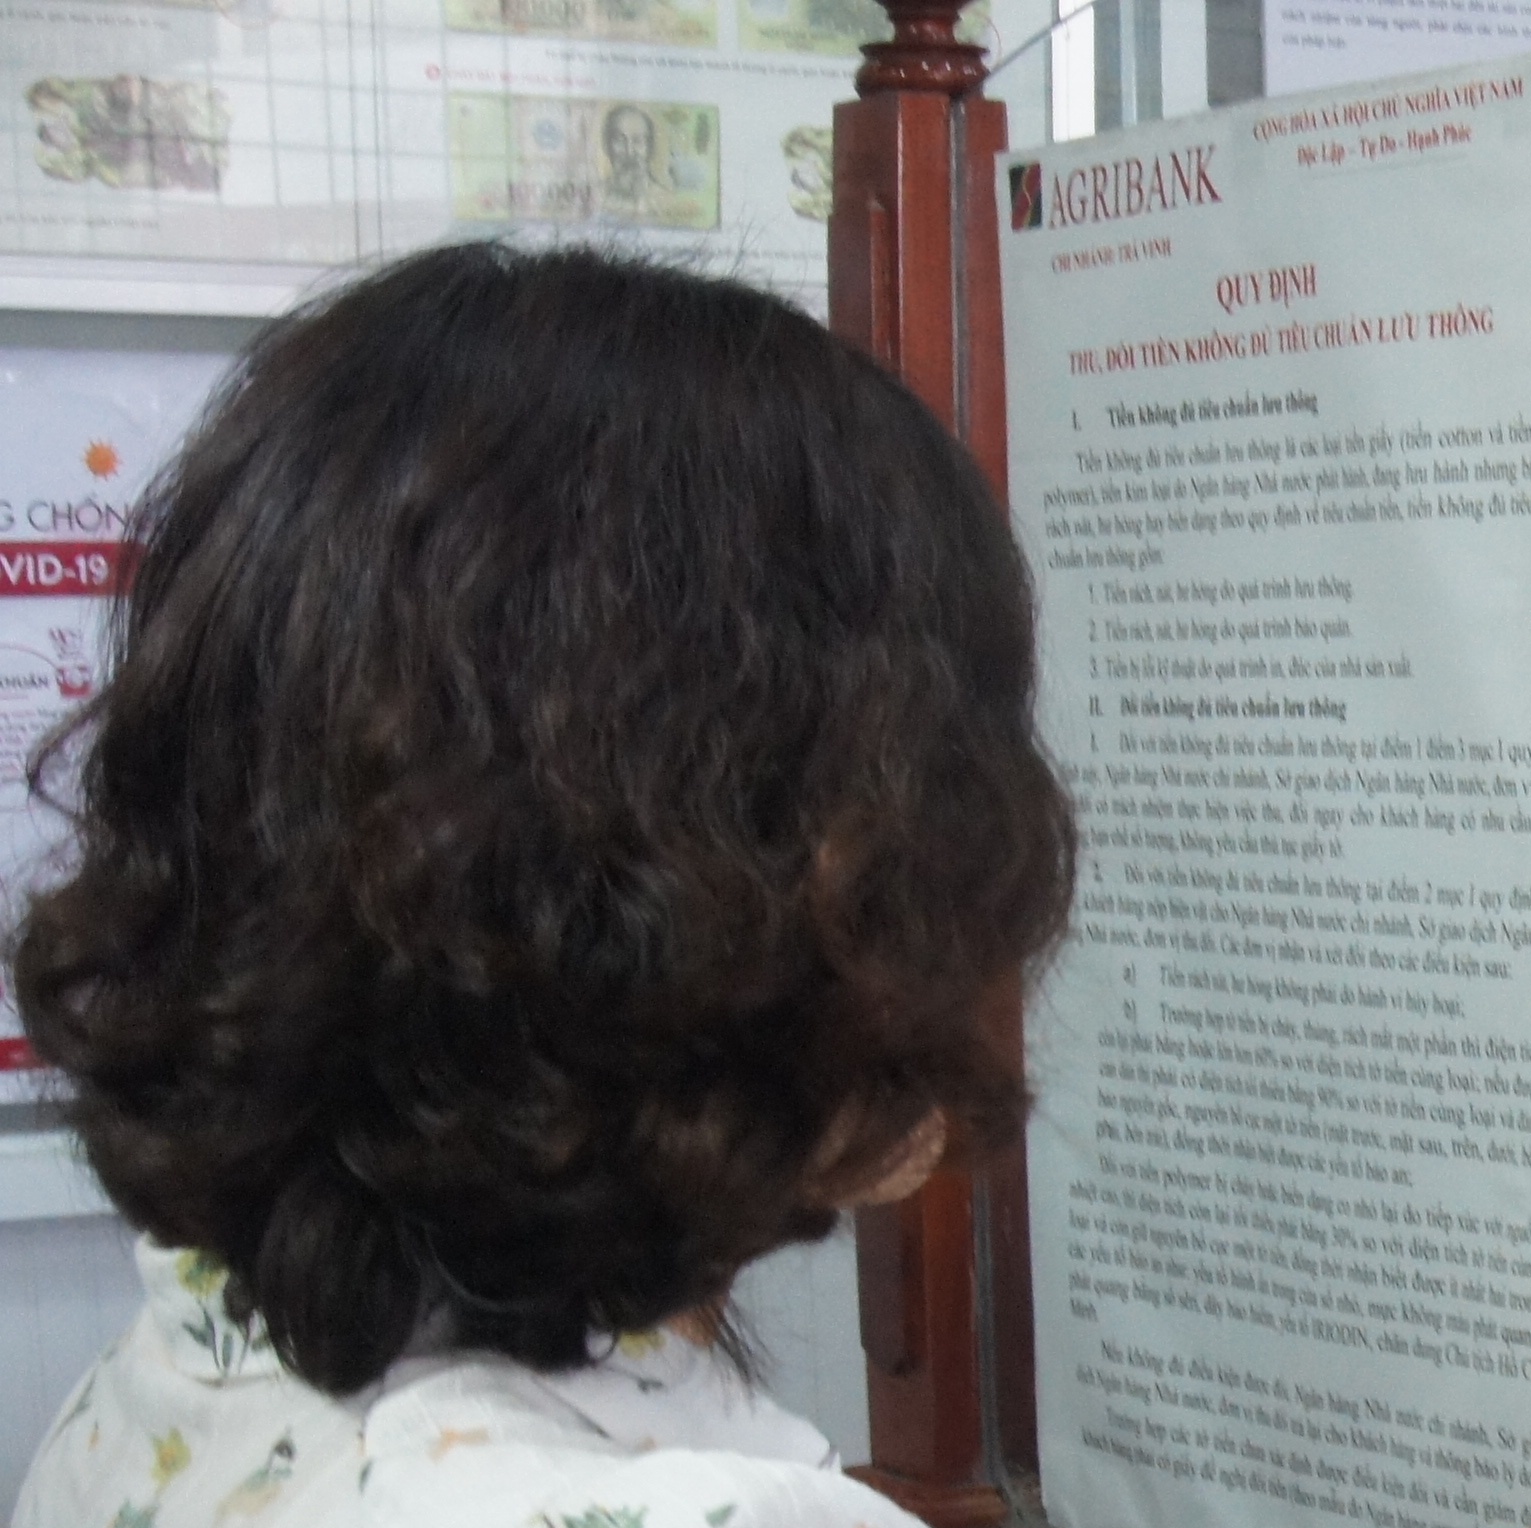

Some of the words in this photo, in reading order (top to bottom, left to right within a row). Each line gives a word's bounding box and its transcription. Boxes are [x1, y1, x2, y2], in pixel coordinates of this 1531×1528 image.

[1252, 117, 1286, 146] CỘNG
[1290, 110, 1316, 134] HÒA
[1320, 106, 1340, 129] XÃ
[1342, 101, 1370, 131] HỘI
[1370, 94, 1400, 121] CHỦ
[1404, 87, 1450, 115] NGHĨA
[1452, 81, 1484, 111] VIỆT
[1488, 76, 1524, 102] NAM
[1050, 146, 1221, 229] AGRIBANK
[1216, 273, 1260, 316] QUY
[1268, 263, 1318, 308] ĐỊNH
[1106, 341, 1136, 371] ĐỔI
[1140, 335, 1182, 367] TIỀN
[1184, 327, 1246, 363] KHÔNG
[1250, 325, 1272, 356] ĐỦ
[1278, 320, 1312, 354] TIÊU
[1314, 314, 1372, 350] CHUẨN
[1378, 313, 1418, 344] LƯU
[1426, 300, 1494, 339] THÔNG
[1106, 402, 1134, 428] Tiền
[1138, 400, 1176, 429] không
[1178, 398, 1194, 422] đủ
[1196, 398, 1220, 421] tiêu
[1220, 391, 1260, 418] chuẩn
[1260, 392, 1282, 415] lưu
[1284, 390, 1318, 418] thông
